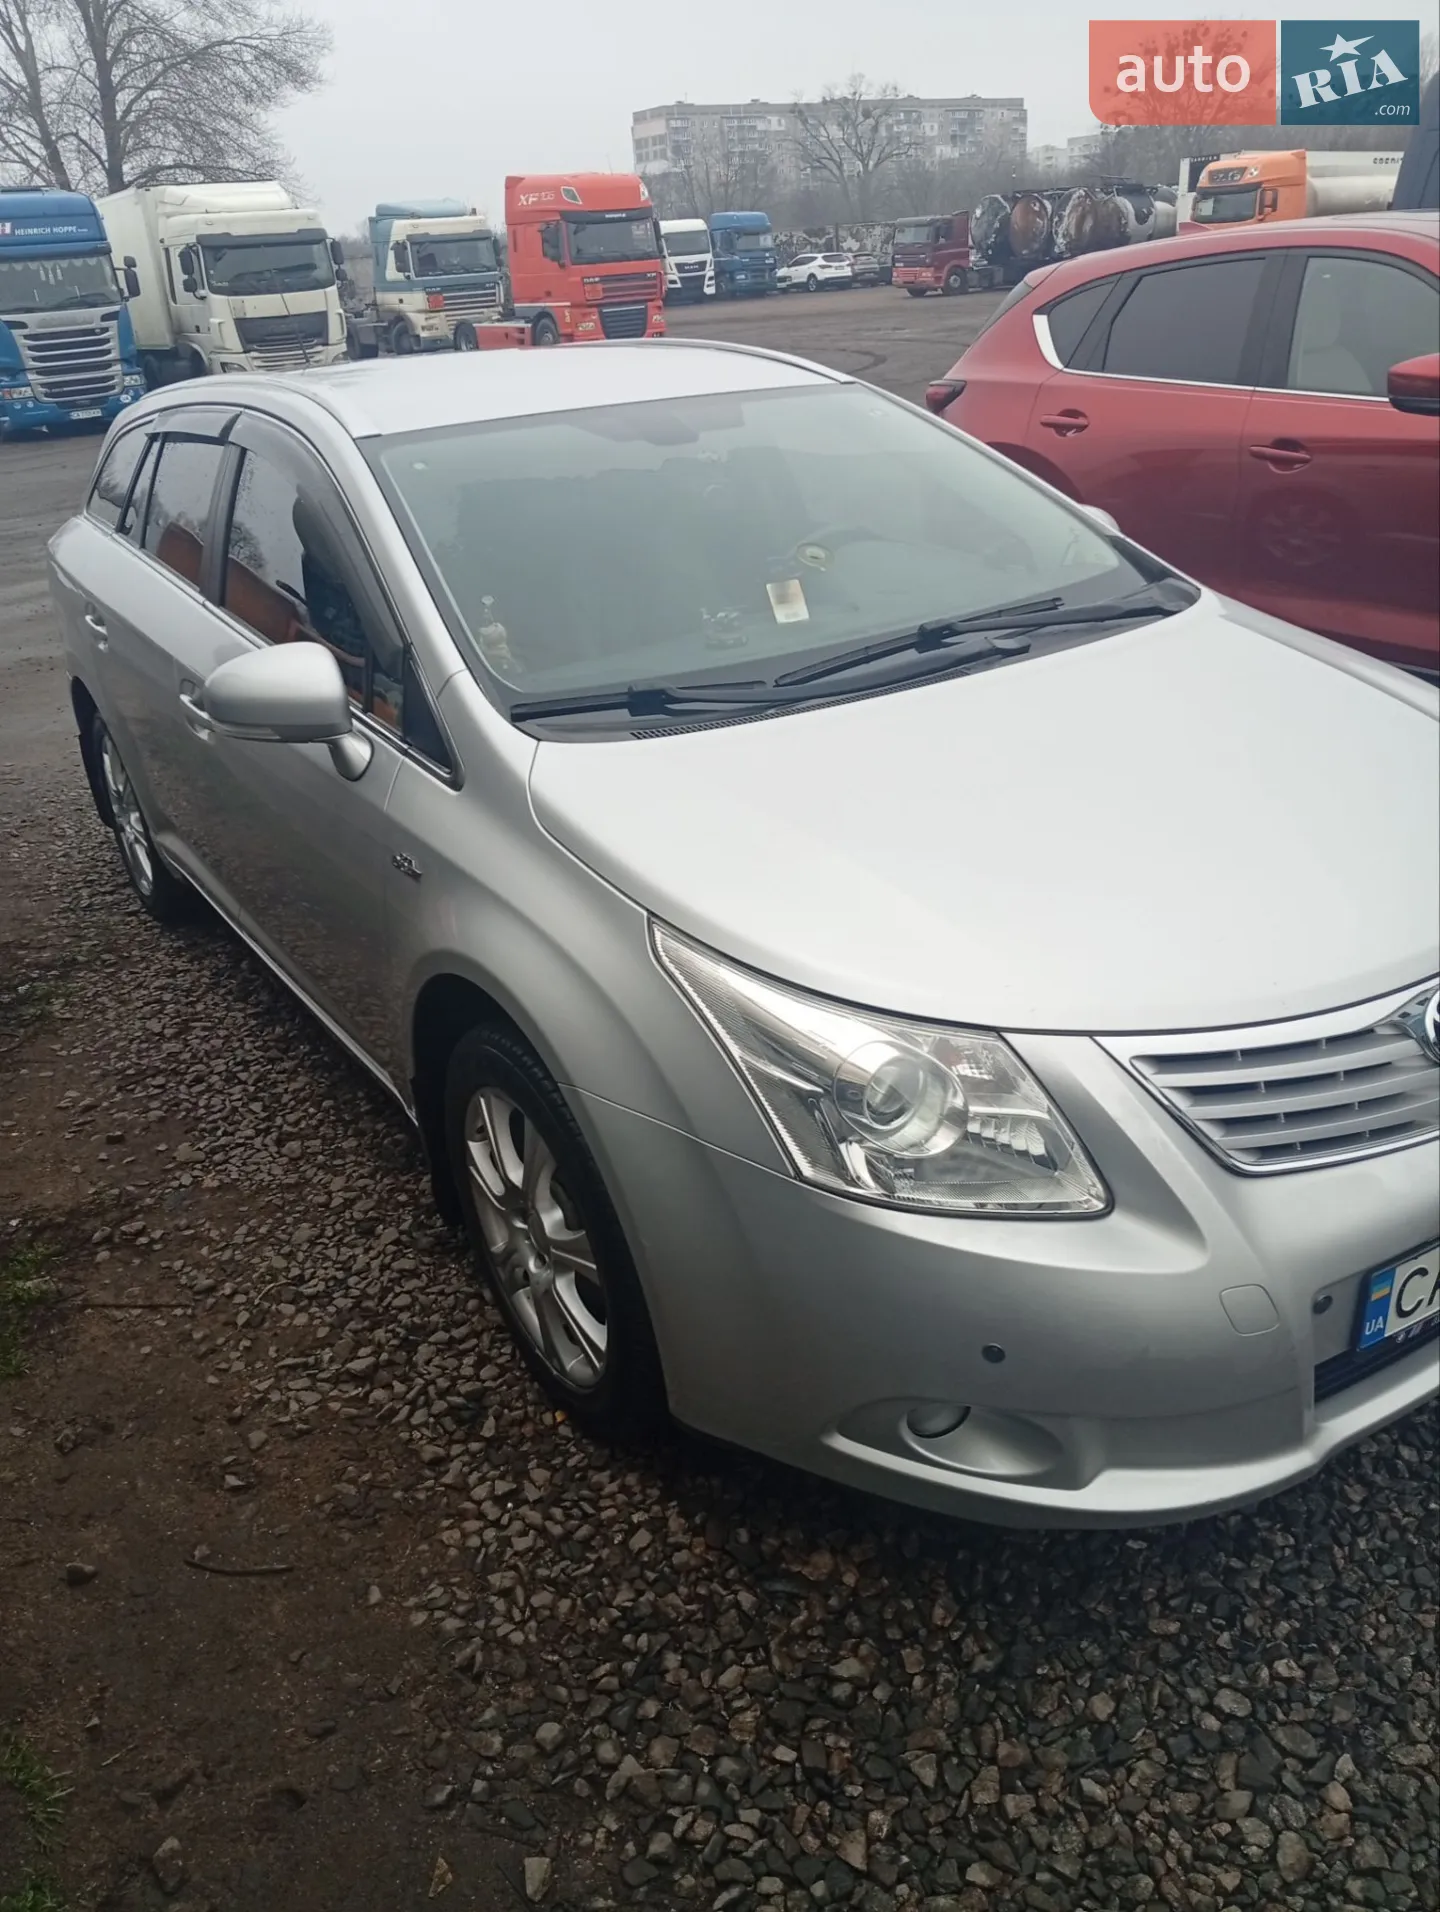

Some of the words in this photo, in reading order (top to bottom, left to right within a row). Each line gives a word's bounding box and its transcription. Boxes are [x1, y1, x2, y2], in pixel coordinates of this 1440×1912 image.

[518, 192, 539, 206] XF
[15, 227, 51, 236] HEINRICH
[53, 226, 77, 234] HOPPE
[1365, 1316, 1385, 1335] UA
